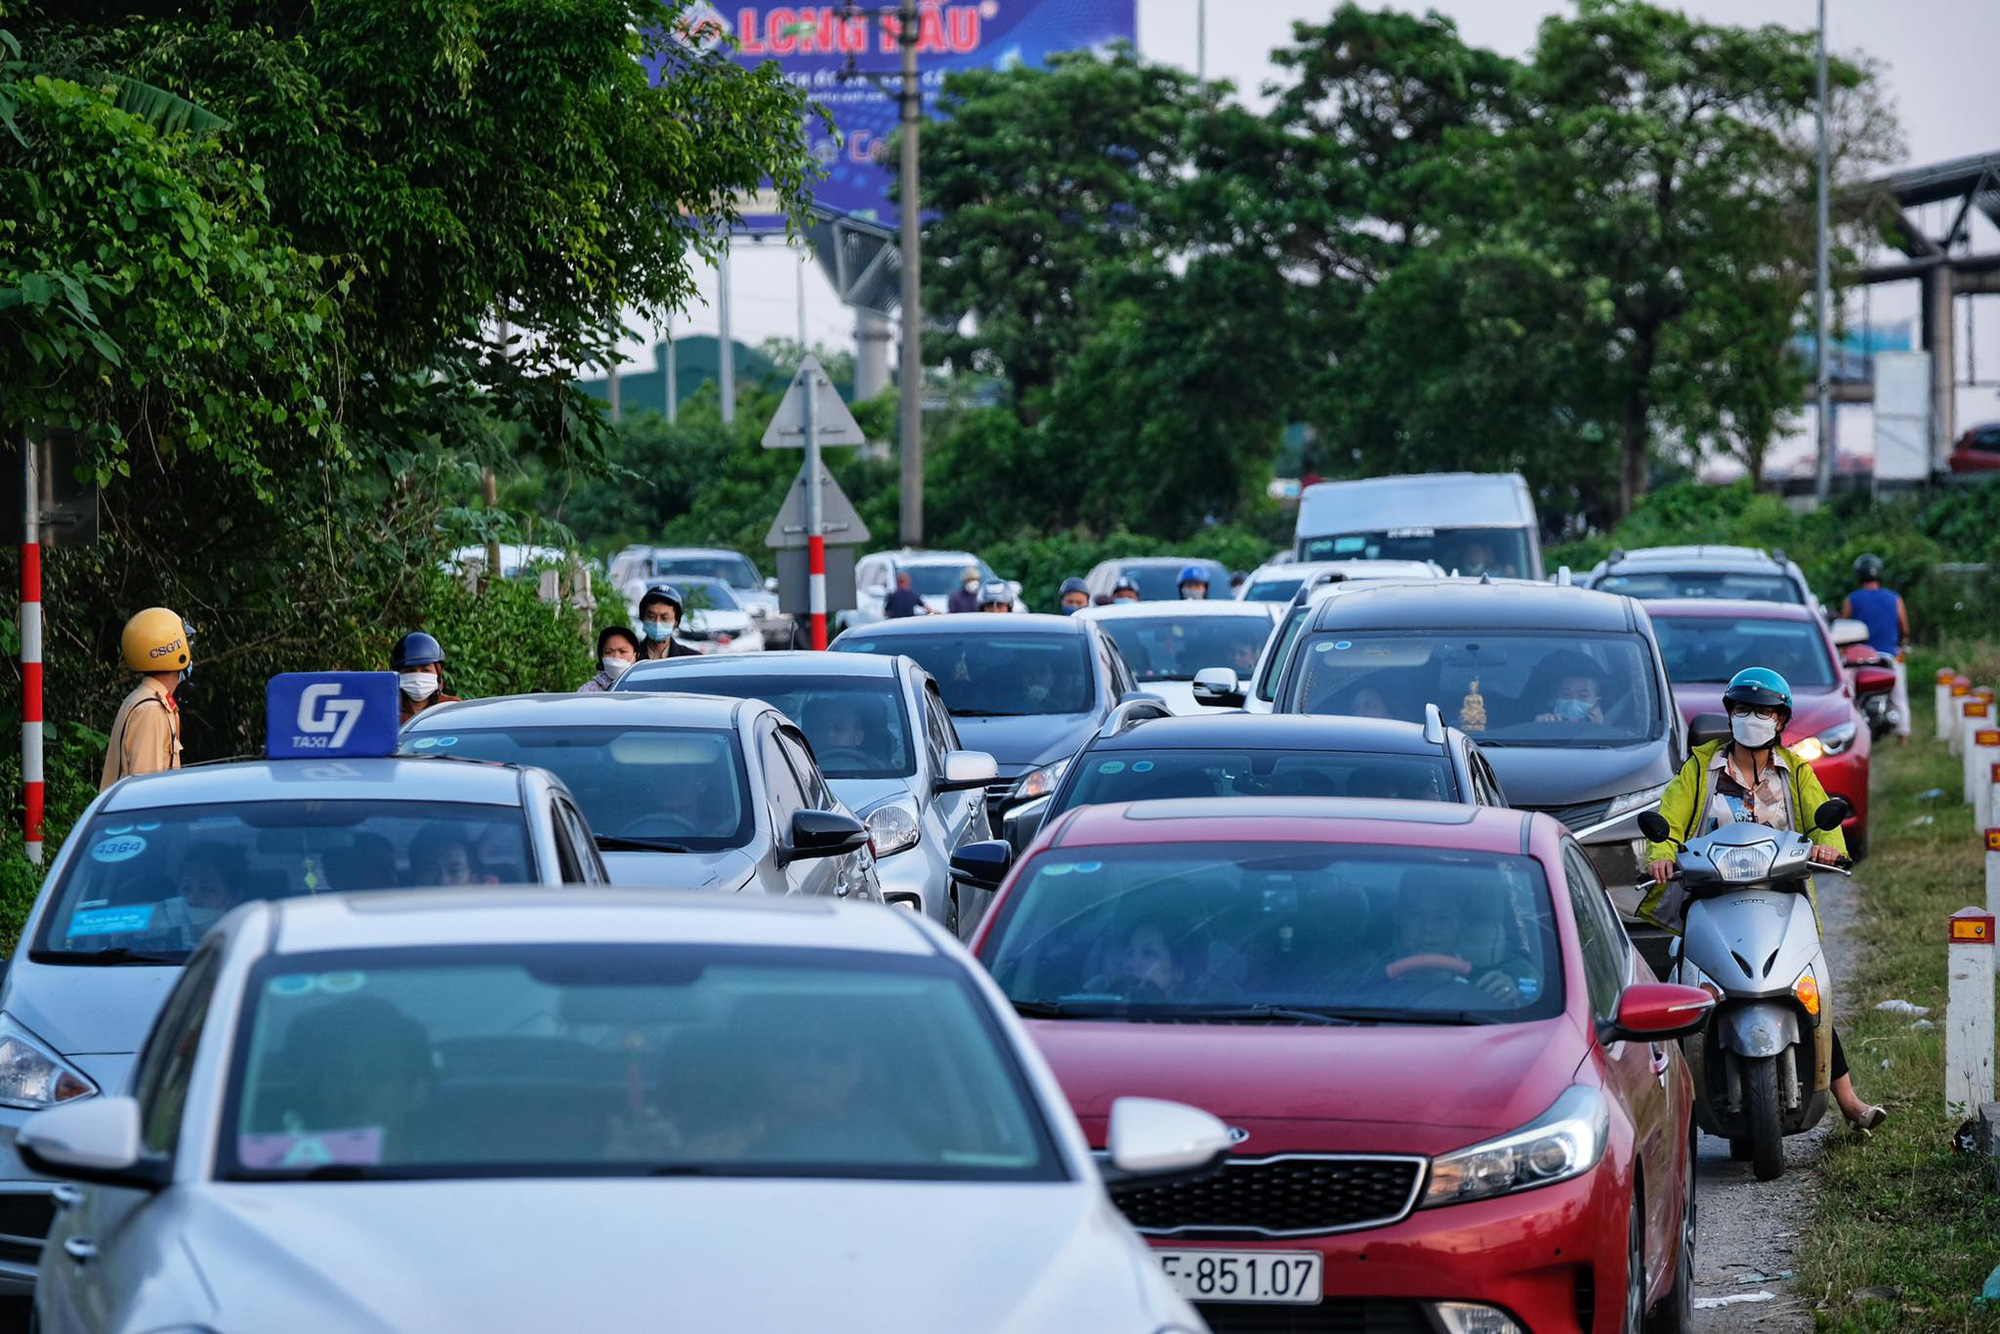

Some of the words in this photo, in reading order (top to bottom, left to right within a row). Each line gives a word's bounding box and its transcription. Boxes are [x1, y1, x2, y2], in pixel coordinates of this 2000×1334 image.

[737, 7, 868, 55] LONG
[149, 639, 181, 659] CSGT
[297, 683, 365, 748] G7
[291, 736, 328, 748] TAXI
